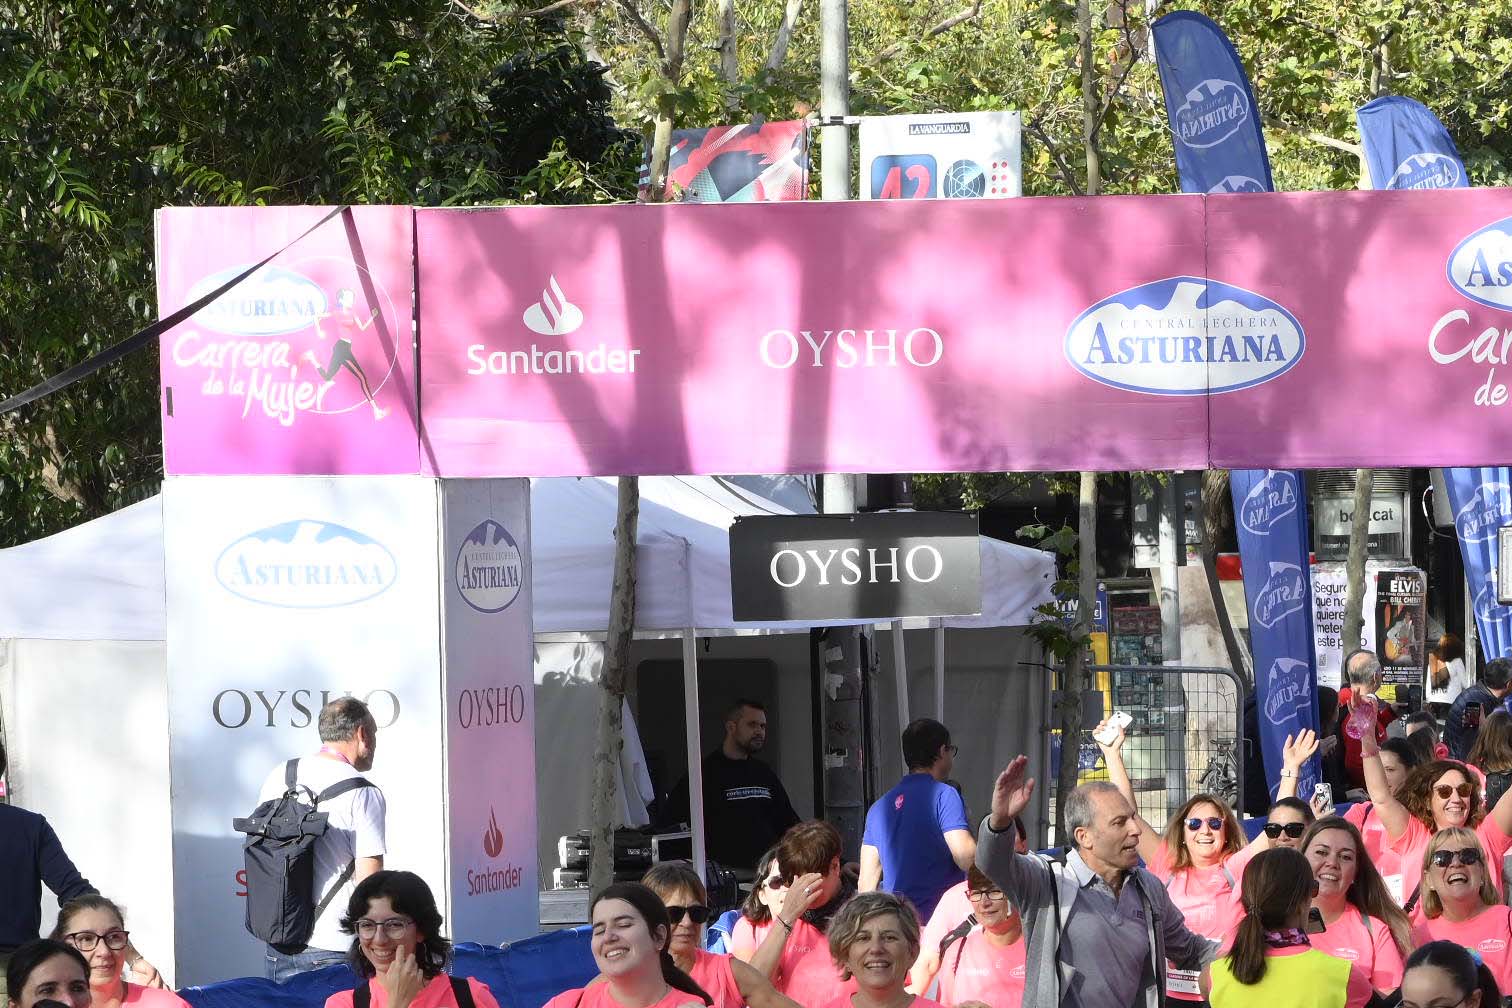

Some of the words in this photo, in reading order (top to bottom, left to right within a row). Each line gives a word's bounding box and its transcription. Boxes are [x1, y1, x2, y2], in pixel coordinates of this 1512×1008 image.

[920, 122, 970, 134] VANGUARDIA
[1120, 316, 1198, 330] CENTRAL
[1203, 315, 1279, 329] LECHERA
[173, 330, 292, 368] Carrera
[467, 344, 641, 375] Santander
[759, 327, 944, 369] OYSHO
[1084, 321, 1287, 364] ASTURIANA
[202, 374, 222, 395] de
[229, 374, 244, 395] la
[243, 366, 335, 427] Mujer
[1474, 368, 1508, 406] de
[231, 552, 384, 586] ASTURIANA
[460, 552, 519, 590] ASTURIANA
[769, 544, 943, 587] OYSHO
[1315, 597, 1332, 609] que
[1390, 580, 1421, 592] ELVIS
[1318, 635, 1336, 647] este
[458, 684, 525, 729] OYSHO
[467, 863, 523, 896] Santander
